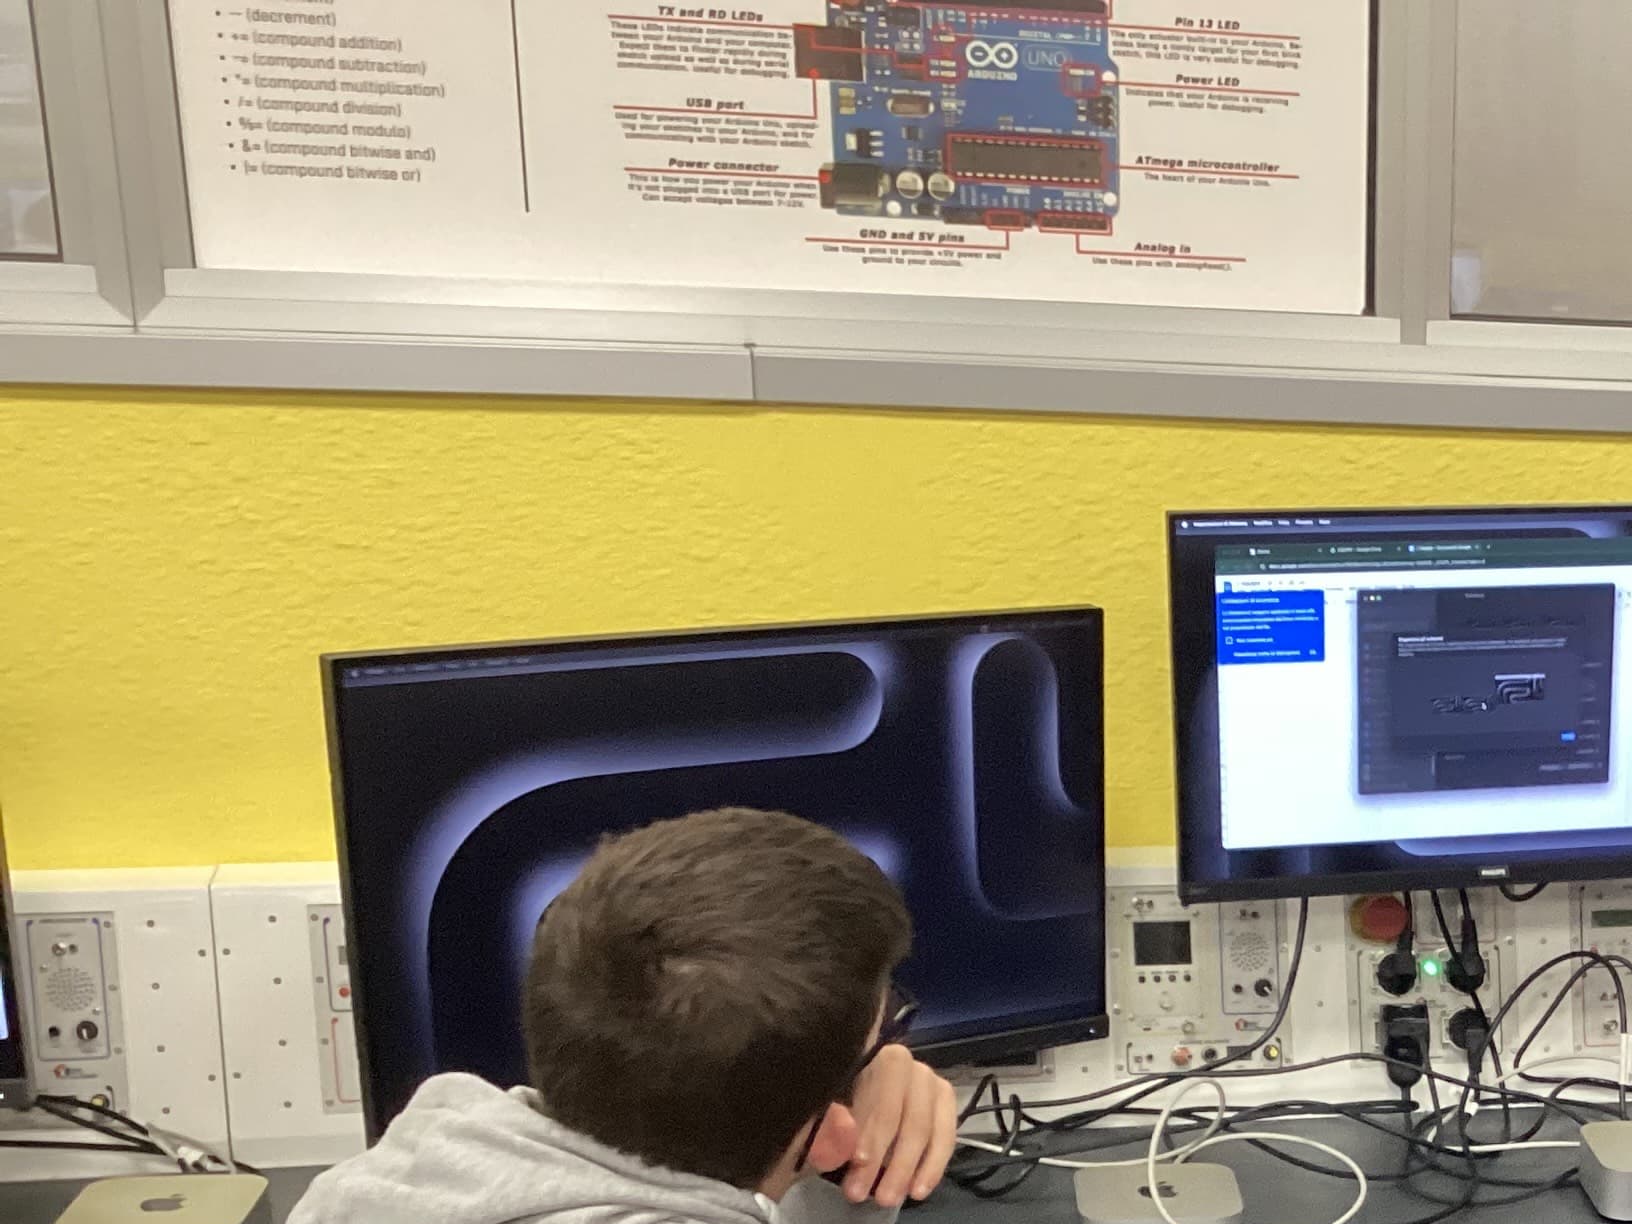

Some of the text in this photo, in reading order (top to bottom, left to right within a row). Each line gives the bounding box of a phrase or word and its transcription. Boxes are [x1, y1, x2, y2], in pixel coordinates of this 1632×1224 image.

[658, 5, 674, 17] TX
[679, 6, 703, 19] and
[731, 9, 763, 22] LEDs
[1174, 16, 1240, 30] Pin 13 LED
[1175, 74, 1239, 86] Power LED
[686, 98, 744, 111] USB port
[668, 158, 778, 172] Power connector
[1135, 156, 1278, 172] ATmega microcontroller
[859, 229, 964, 245] GND and 5V pins
[1134, 242, 1191, 255] Analog in
